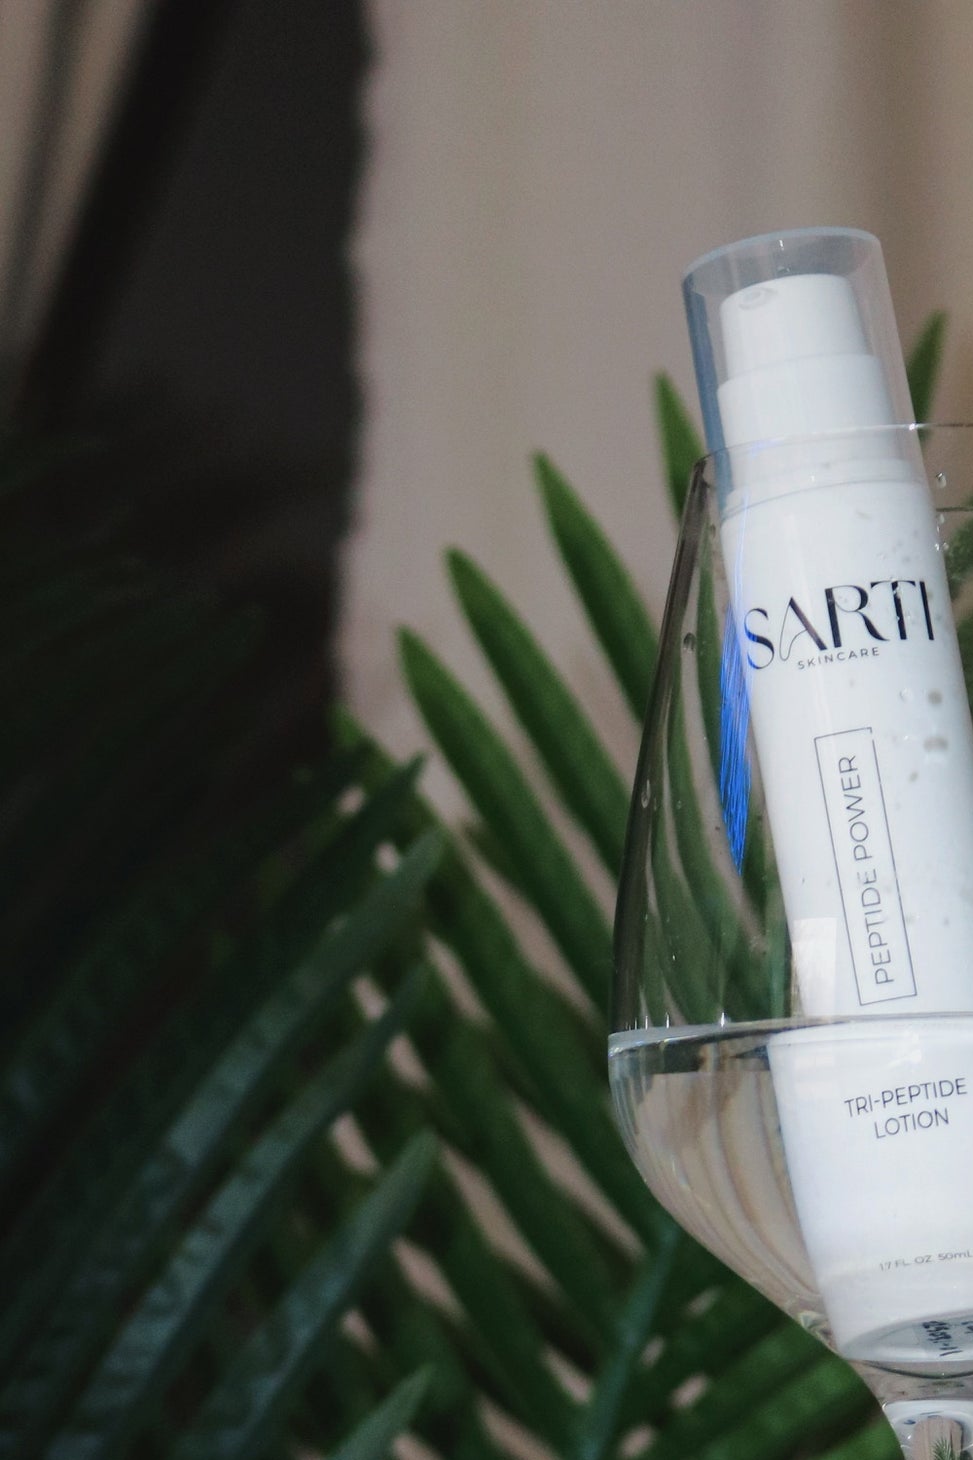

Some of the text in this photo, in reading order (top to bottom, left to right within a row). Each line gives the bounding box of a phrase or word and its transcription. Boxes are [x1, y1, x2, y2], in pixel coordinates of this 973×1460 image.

[744, 580, 934, 669] SARTI
[797, 647, 880, 669] SKINCARE
[838, 755, 894, 984] PEPTIDE POWER
[844, 1078, 967, 1117] TRI-PEPTIDE
[874, 1107, 949, 1139] LOTION
[895, 1258, 910, 1268] FL
[914, 1254, 933, 1264] OZ
